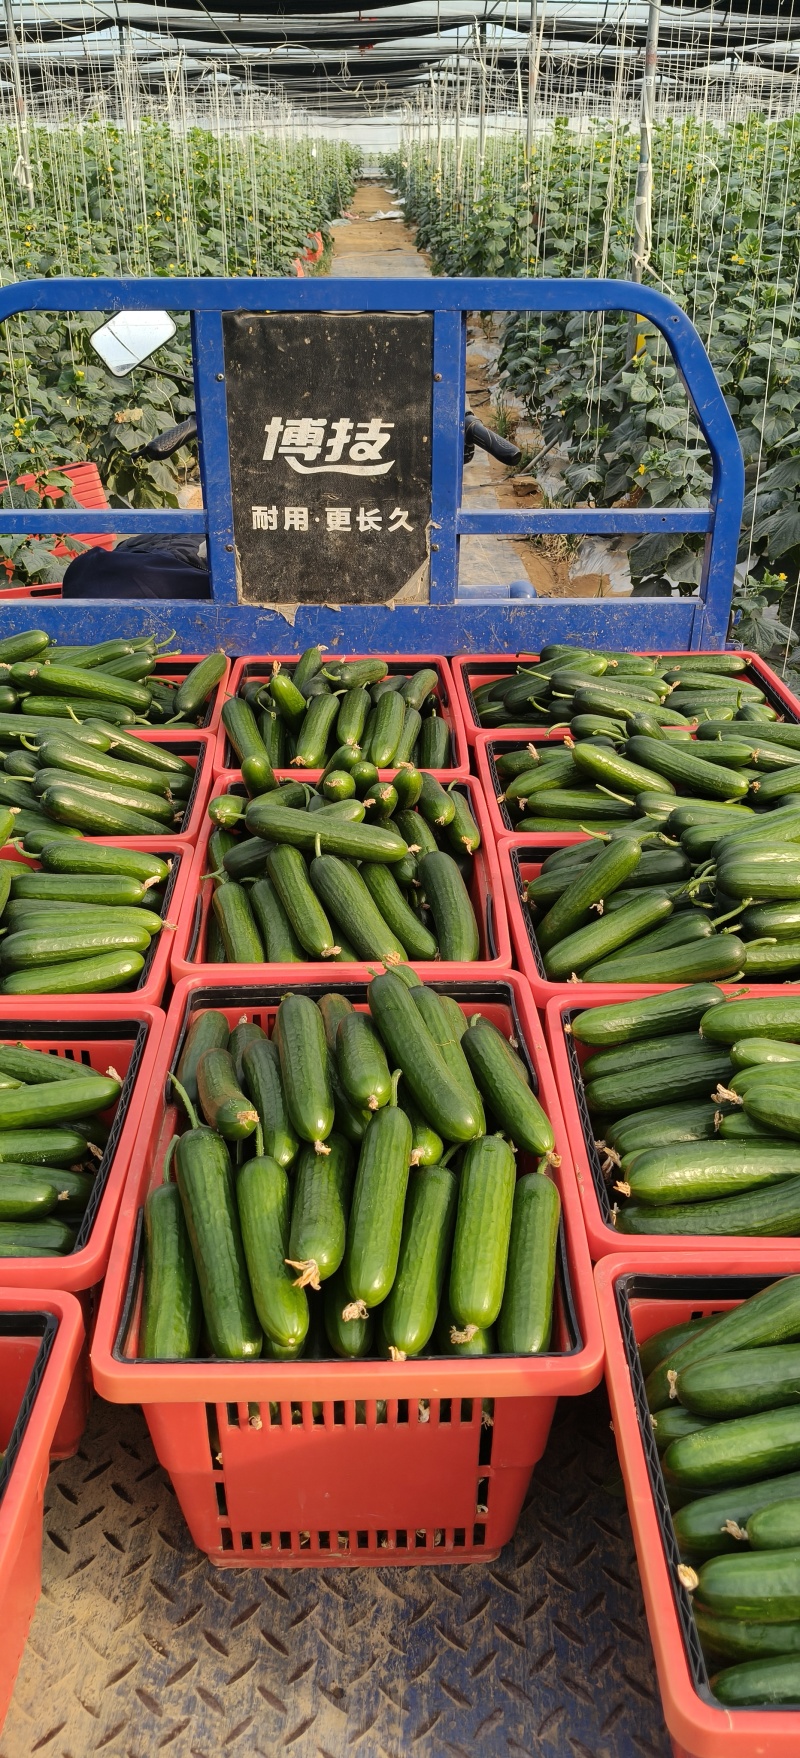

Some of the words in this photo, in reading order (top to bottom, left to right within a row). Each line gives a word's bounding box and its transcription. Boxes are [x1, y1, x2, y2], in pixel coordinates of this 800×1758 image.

[262, 416, 395, 463] 博技
[251, 505, 415, 533] 耐用·更长久
